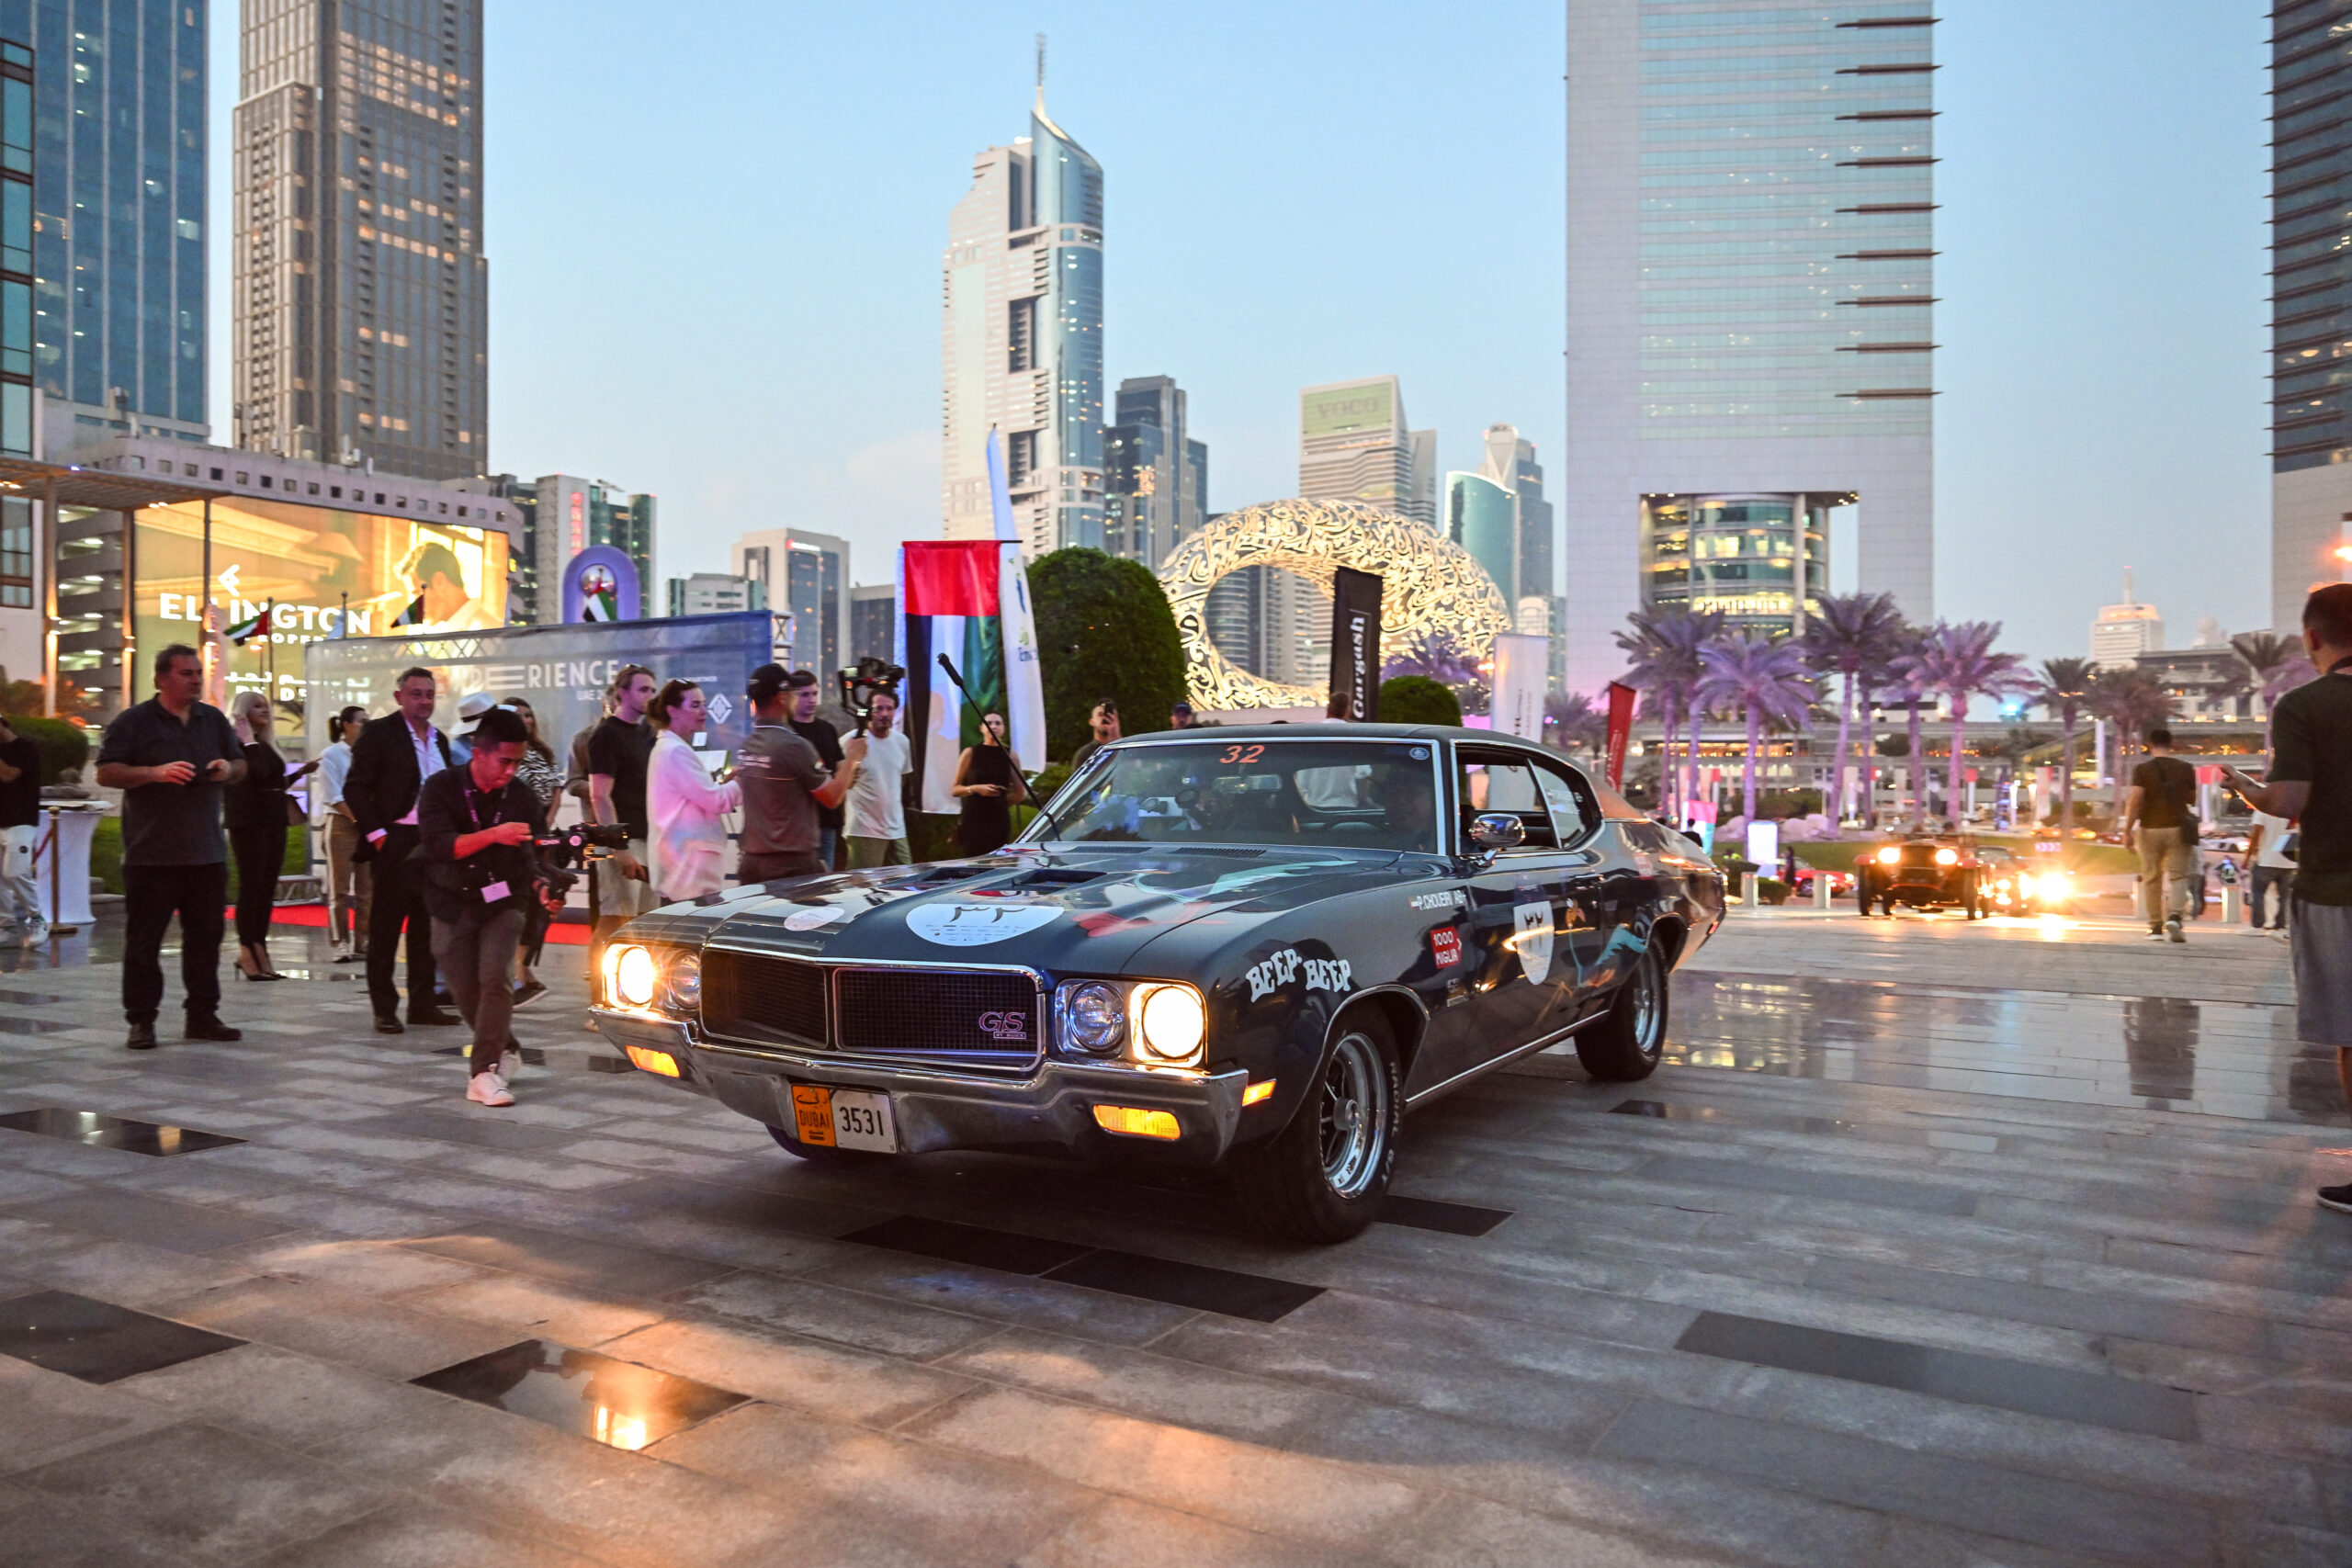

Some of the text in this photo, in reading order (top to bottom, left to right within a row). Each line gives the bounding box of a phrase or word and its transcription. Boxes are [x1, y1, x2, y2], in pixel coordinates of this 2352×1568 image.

[160, 592, 370, 635] ELINGTON
[1220, 745, 1265, 763] 32
[1433, 931, 1454, 946] 1000
[1435, 948, 1459, 965] MIGLIA
[1303, 959, 1351, 992] BEEP
[978, 1011, 1025, 1032] GS
[798, 1110, 831, 1129] DUBAI
[839, 1106, 884, 1136] 3531
